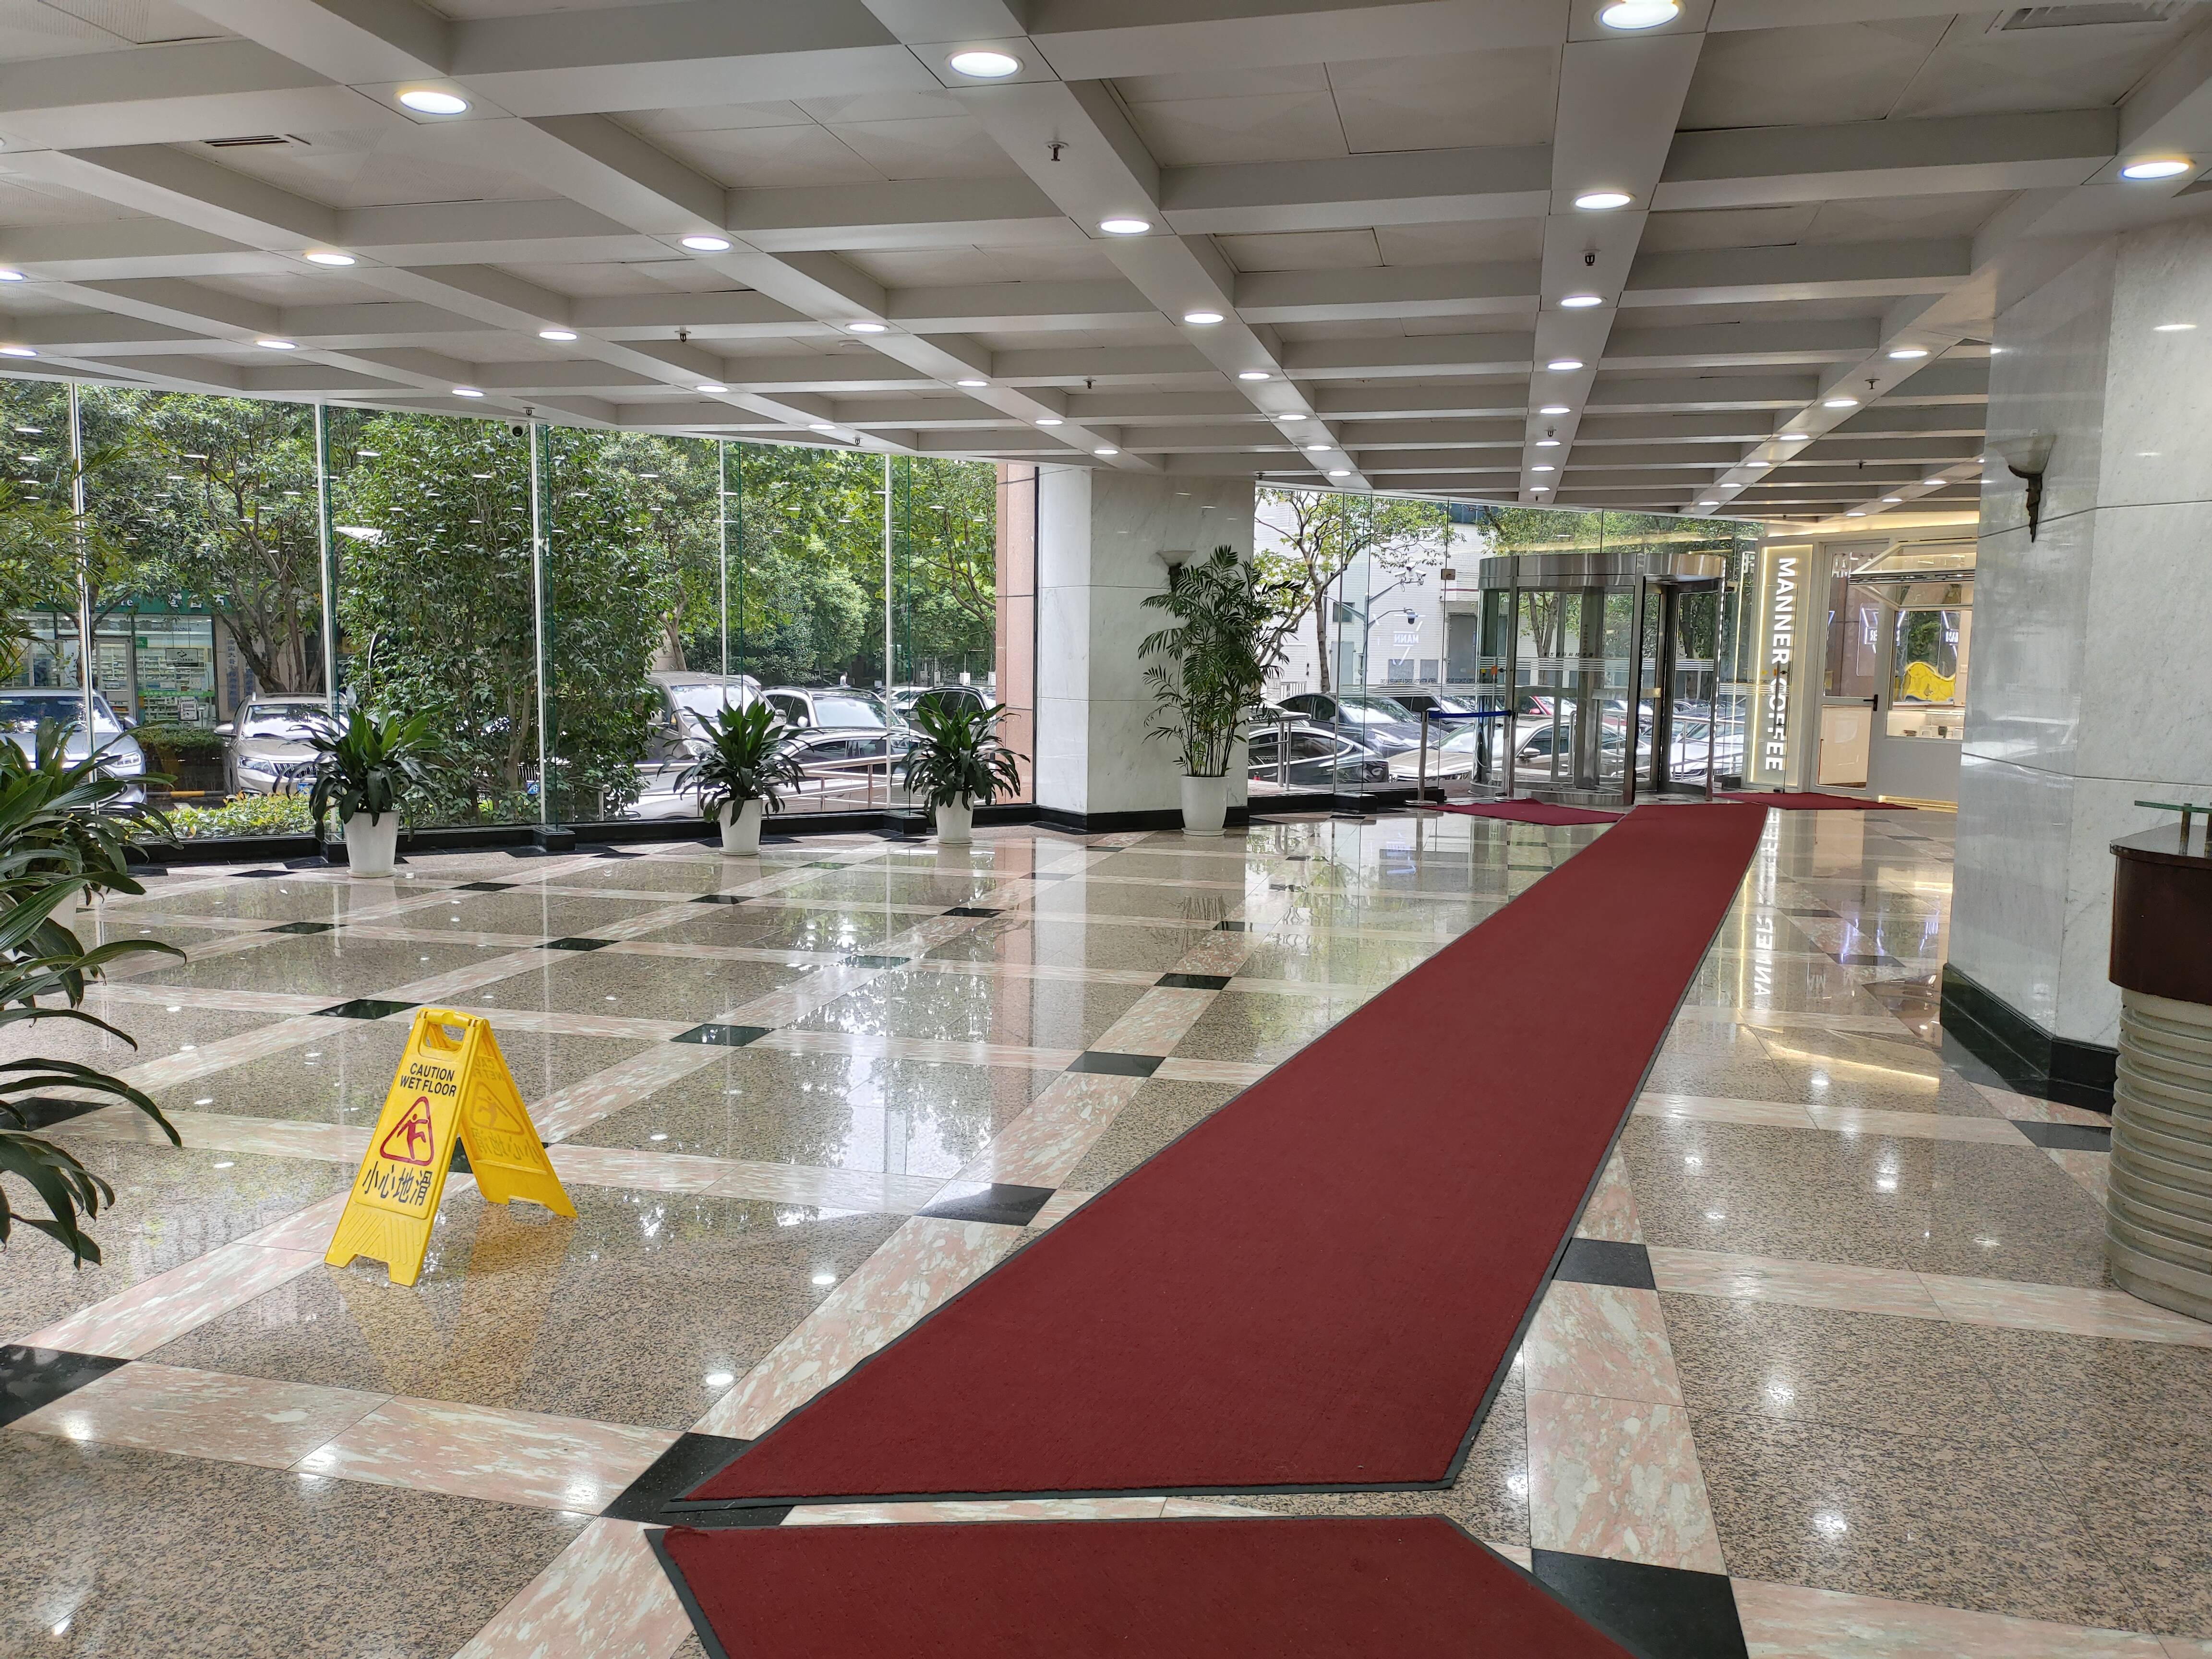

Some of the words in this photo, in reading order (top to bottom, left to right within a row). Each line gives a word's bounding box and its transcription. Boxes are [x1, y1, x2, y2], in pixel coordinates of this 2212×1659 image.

[1772, 558, 1796, 664] MANNER
[1766, 677, 1787, 770] COFFEE
[400, 1075, 422, 1090] WET
[422, 1080, 457, 1097] FLOOR
[410, 1063, 455, 1082] CAUTION
[362, 1161, 433, 1206] 小心地滑
